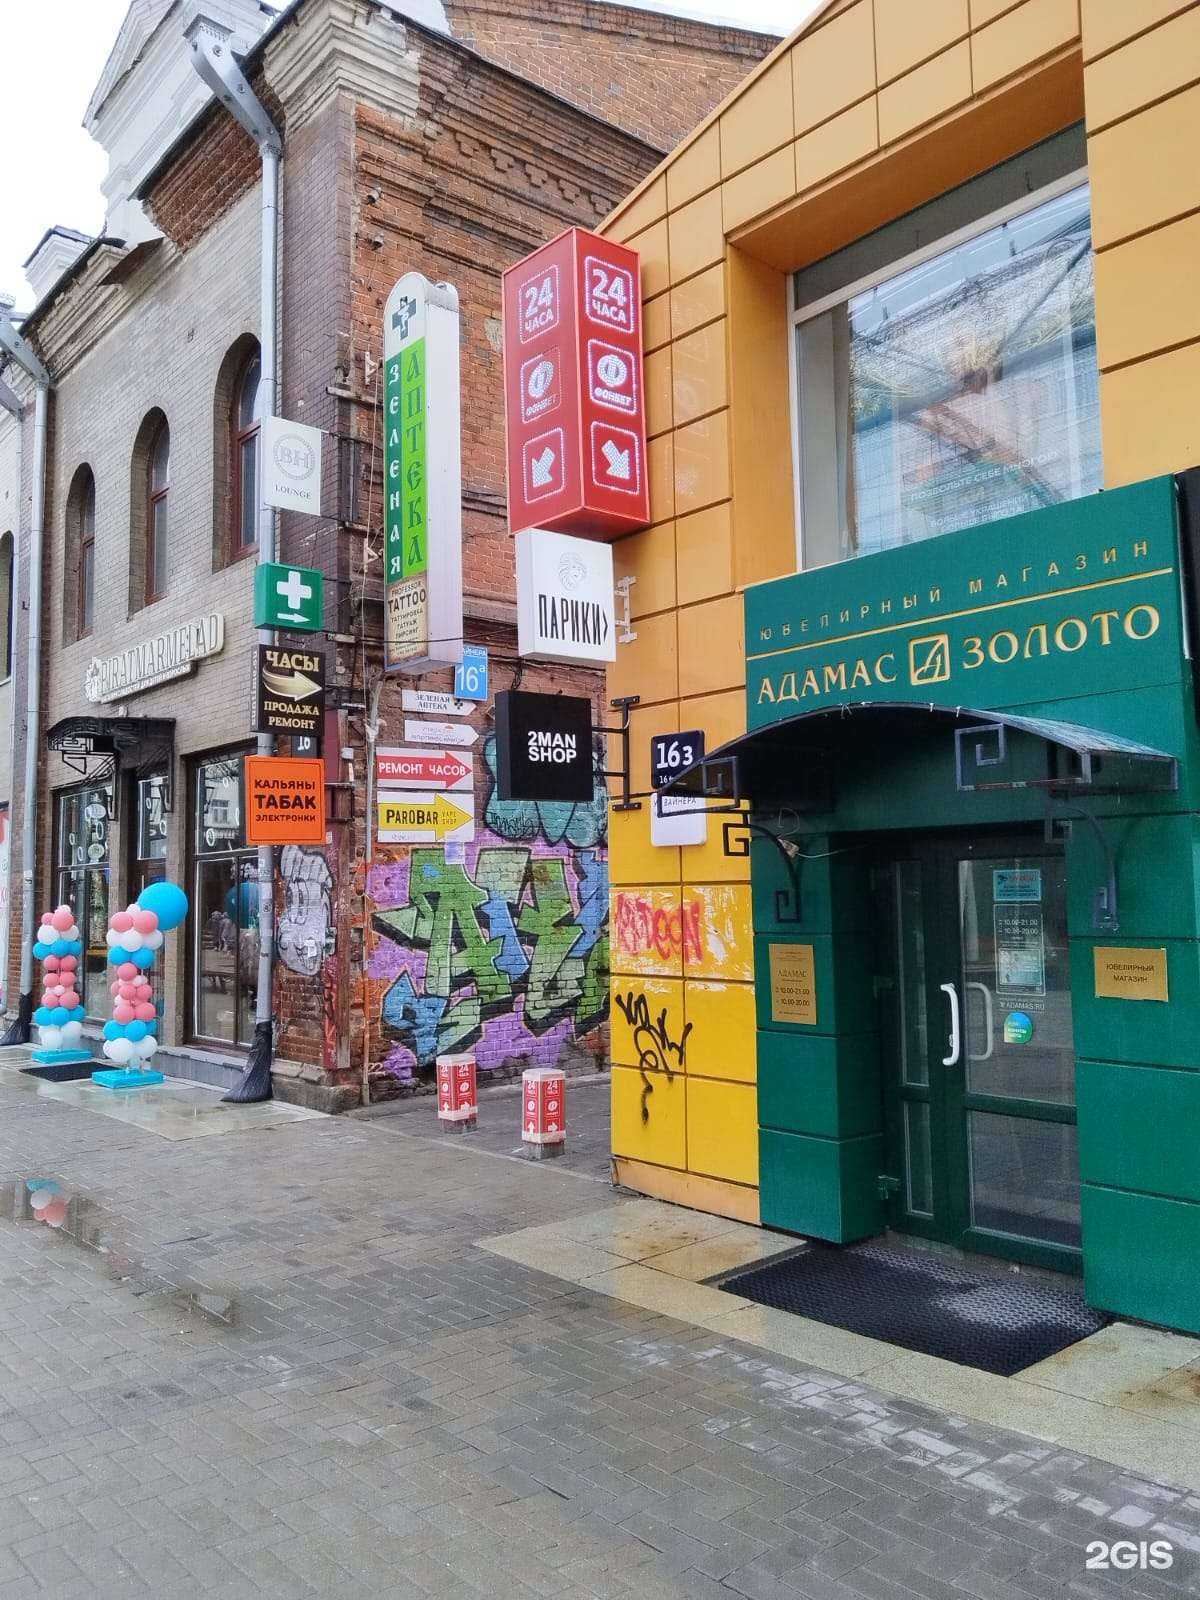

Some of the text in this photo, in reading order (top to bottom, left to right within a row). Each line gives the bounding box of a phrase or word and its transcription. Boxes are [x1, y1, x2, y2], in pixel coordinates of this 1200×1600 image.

[592, 268, 626, 306] 24
[525, 277, 553, 317] 24
[592, 299, 626, 323] ЧАСА
[525, 308, 553, 332] ЧАСА
[406, 350, 424, 568] АПТЕКА
[388, 364, 401, 575] ЗЕЛЕНАЯ
[274, 484, 312, 499] LOUNGE
[760, 540, 1147, 640] ЮВЕЛИРНЫЙ МАГАЗИН
[388, 588, 427, 613] TATTOO
[538, 594, 602, 645] ПАРИКИ
[265, 651, 320, 672] ЧАСЫ
[757, 652, 897, 704] АДАМАС
[962, 604, 1160, 669] ЗОЛОТО
[416, 693, 450, 703] ЗЕЛЕНАЯ
[417, 702, 447, 710] АПТЕКА
[264, 701, 320, 716] ПРОДАЖА
[269, 716, 315, 730] РЕМОНТ
[527, 731, 577, 748] 2MAN
[528, 746, 577, 763] SHOP
[379, 762, 466, 776] РЕМОНТ ЧАСОВ
[254, 779, 316, 792] КАЛЬЯНЫ
[254, 794, 317, 810] ТАБАК
[255, 813, 316, 823] ЭЛЕКТРОНКИ
[1106, 963, 1155, 972] ЮВЕЛИРНЫЙ
[1113, 974, 1148, 983] МАГАЗИН
